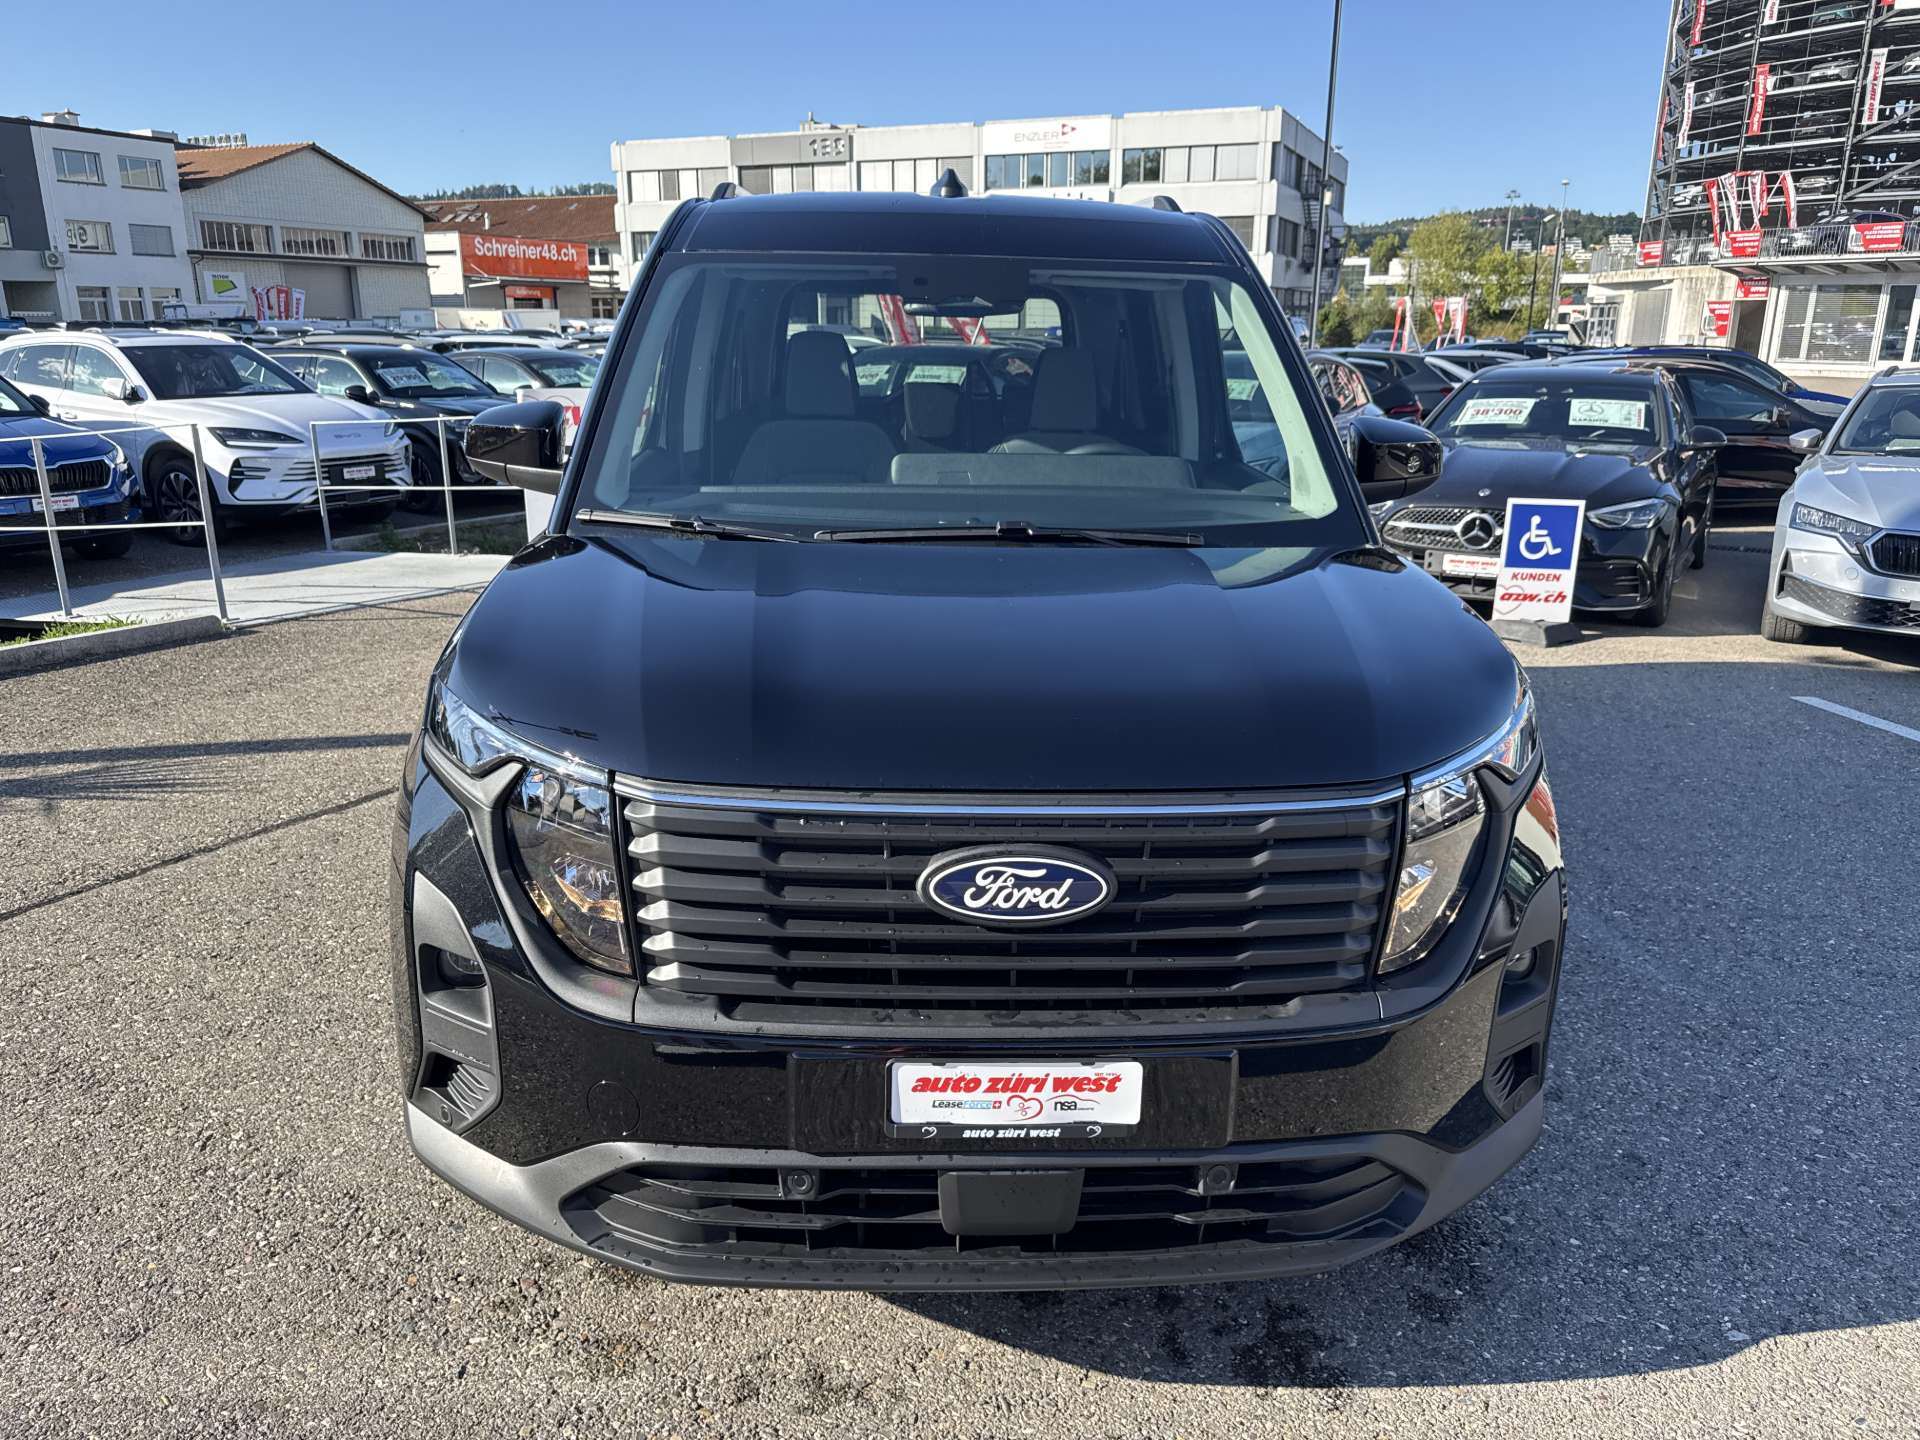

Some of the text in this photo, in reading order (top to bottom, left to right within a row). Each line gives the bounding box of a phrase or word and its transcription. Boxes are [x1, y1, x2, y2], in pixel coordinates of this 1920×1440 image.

[1014, 131, 1060, 143] ENZLER
[474, 236, 577, 262] Schreiner48.ch
[1511, 572, 1562, 582] KUNDEN
[1500, 591, 1567, 603] azw.ch
[964, 866, 1075, 910] Ford
[911, 1072, 1122, 1093] auto züri west
[1054, 1101, 1078, 1111] nsa
[962, 1127, 1061, 1138] auto züri west
